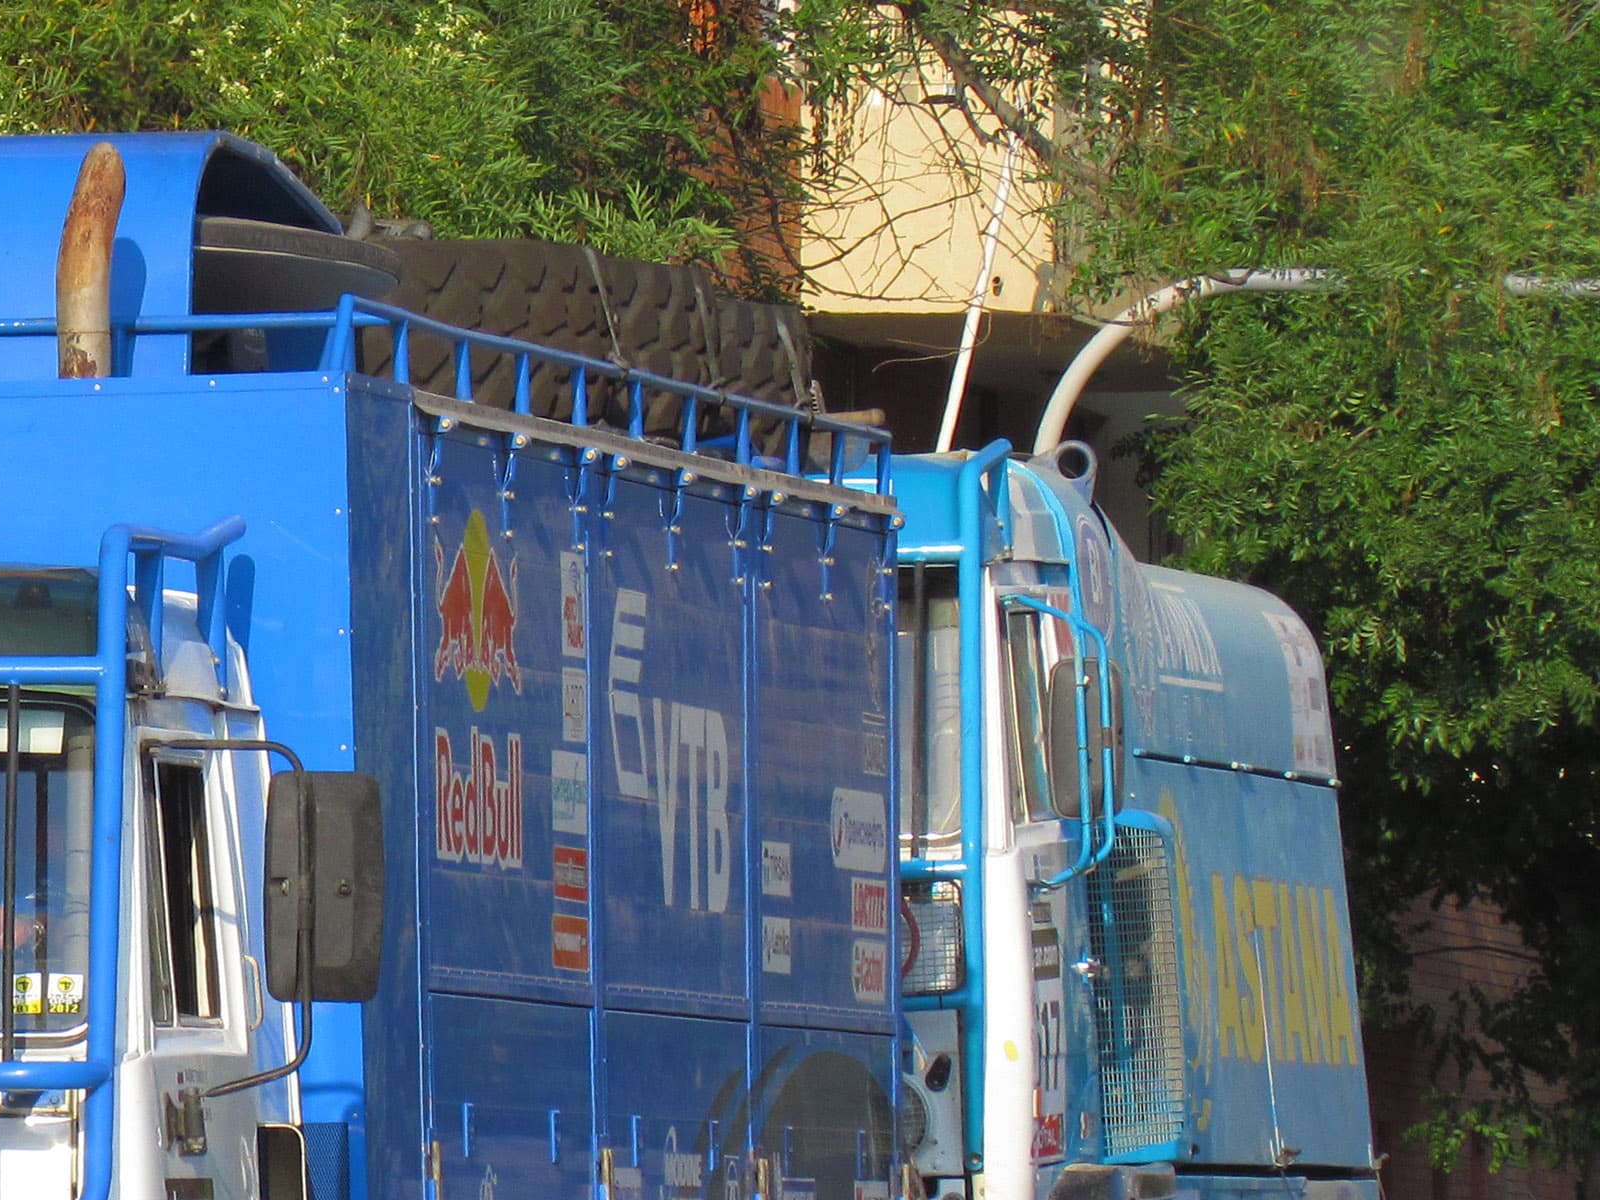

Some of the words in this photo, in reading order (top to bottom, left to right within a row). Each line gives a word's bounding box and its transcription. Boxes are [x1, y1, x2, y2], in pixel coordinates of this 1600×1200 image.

[435, 726, 479, 861] Red
[480, 735, 523, 868] Bull
[653, 697, 730, 914] VTB
[48, 1003, 79, 1014] 2012
[1210, 872, 1358, 1068] ASTANA
[664, 1154, 703, 1187] MODINE
